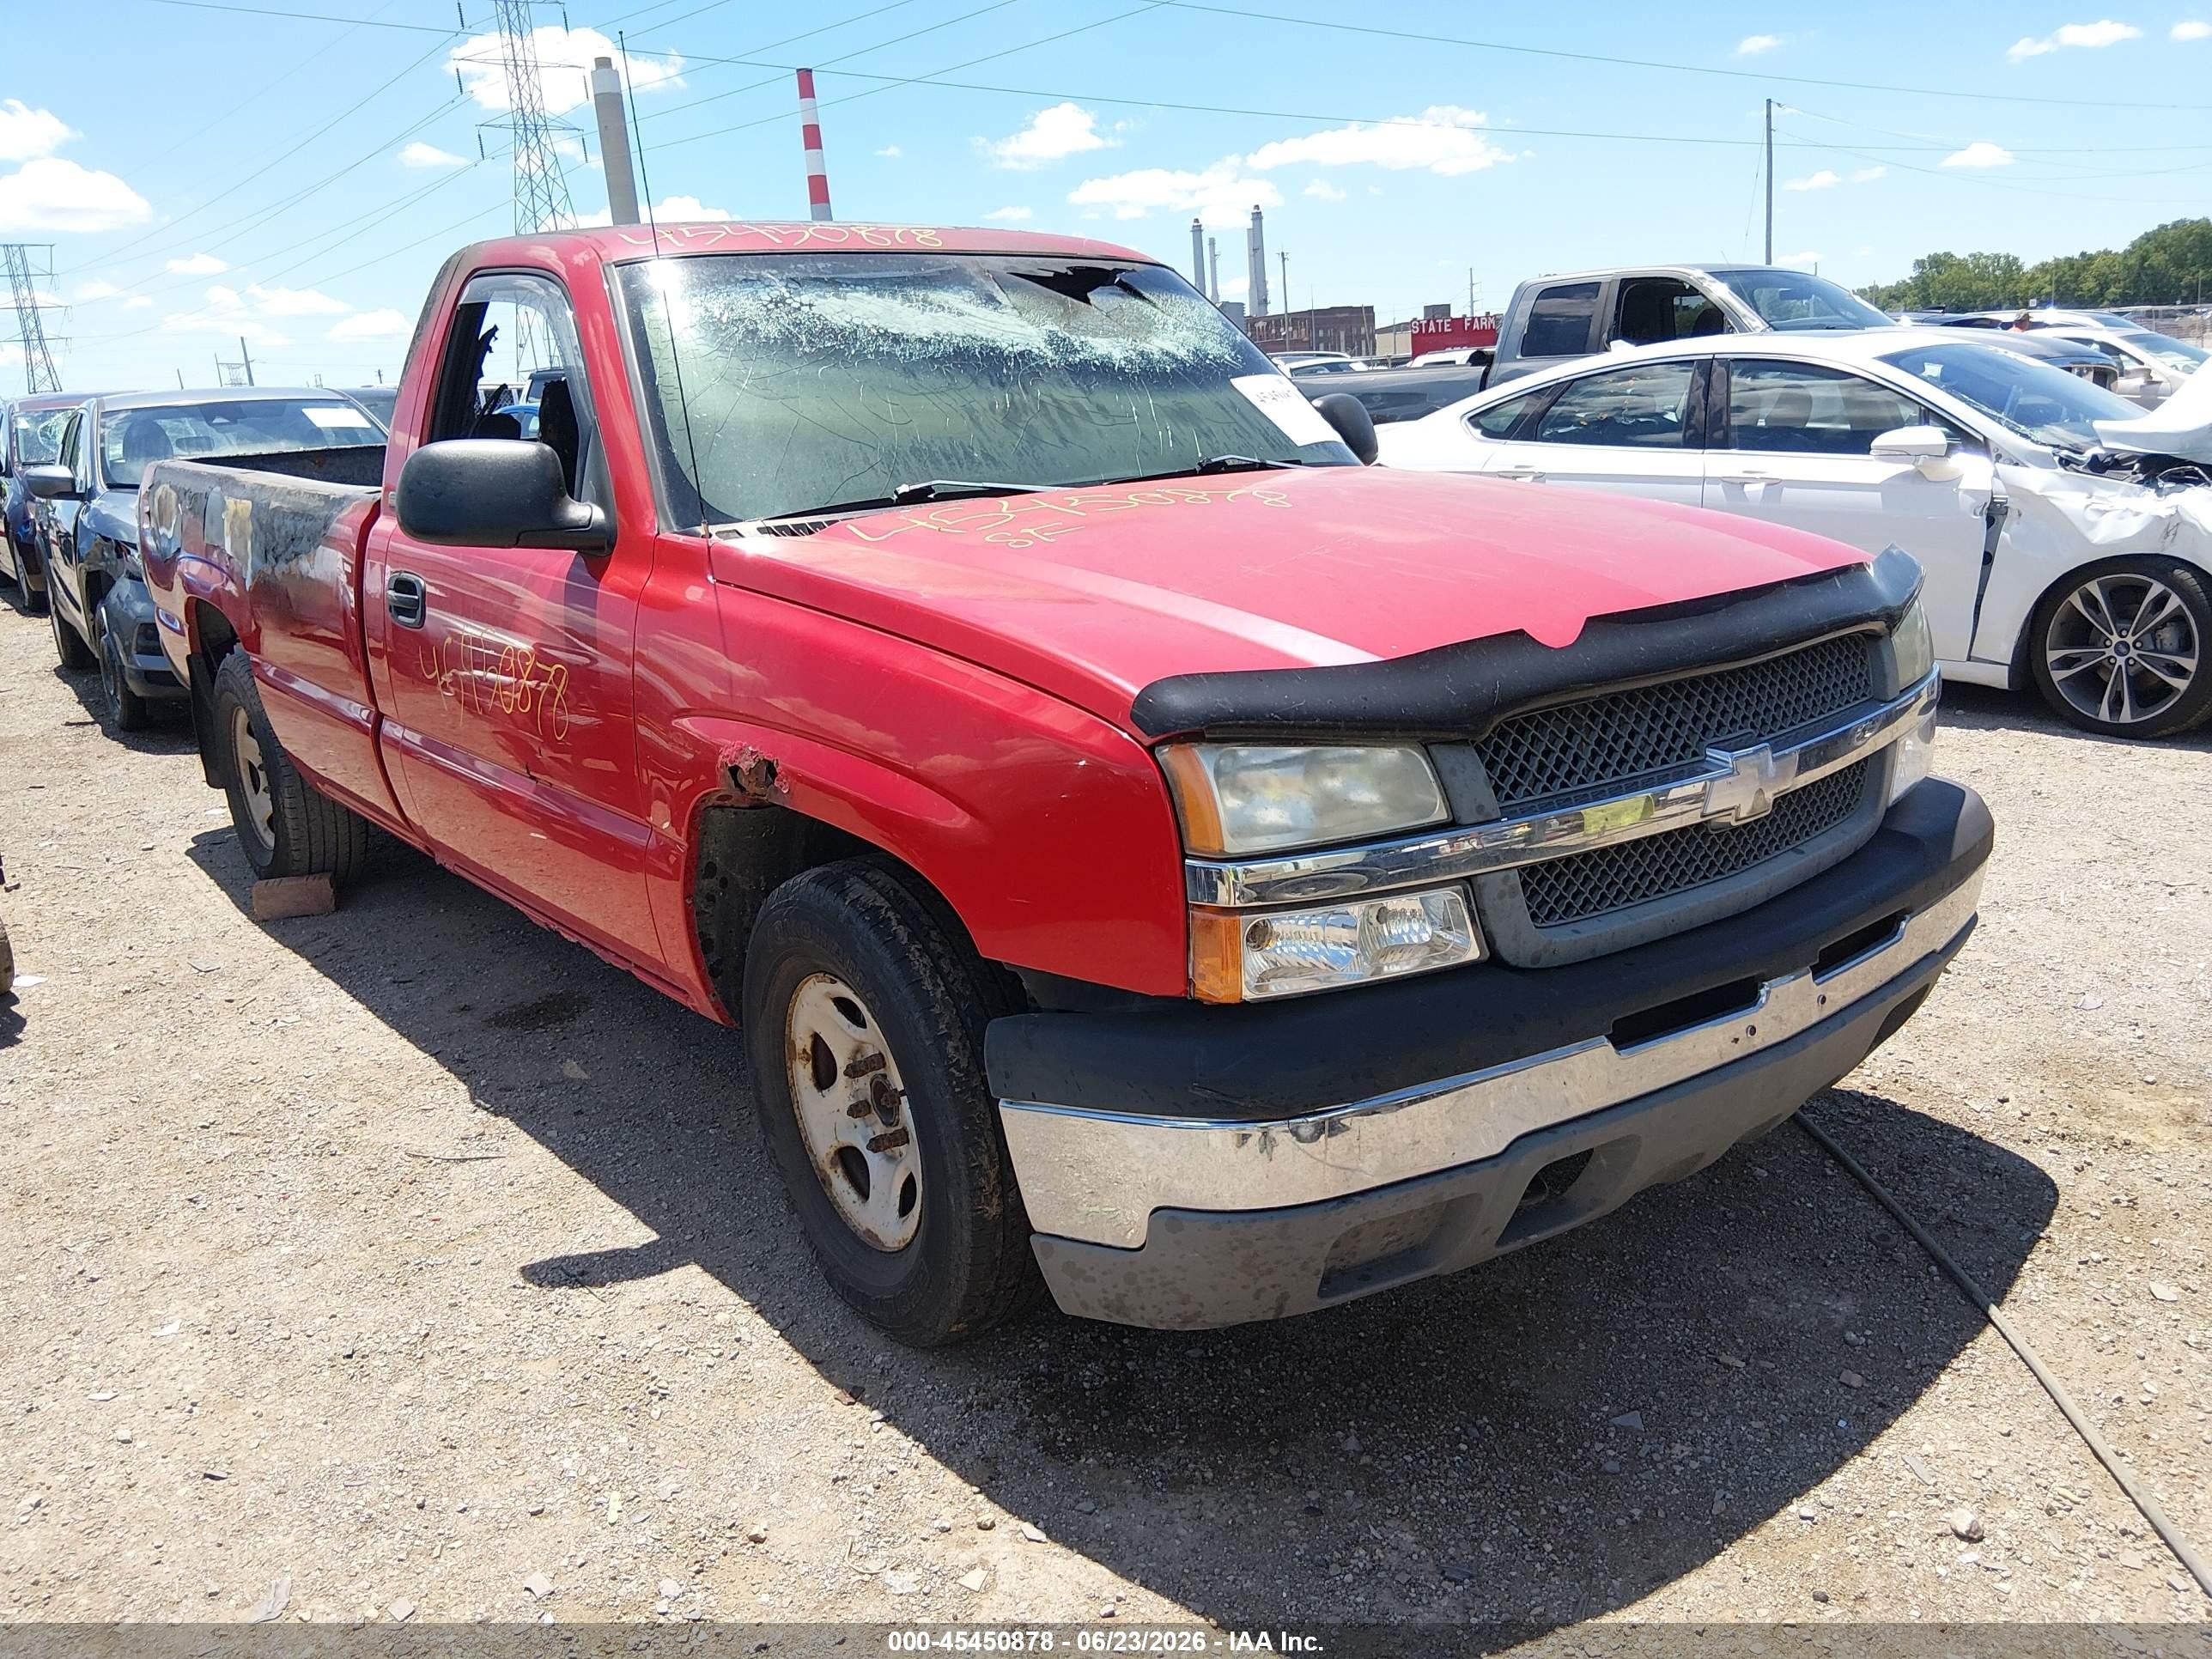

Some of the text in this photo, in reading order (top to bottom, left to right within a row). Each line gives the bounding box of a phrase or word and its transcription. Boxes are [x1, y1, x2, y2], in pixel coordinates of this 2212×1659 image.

[620, 224, 946, 248] 45450878
[1411, 316, 1495, 334] STATE FARM
[845, 487, 1293, 542] 45450878
